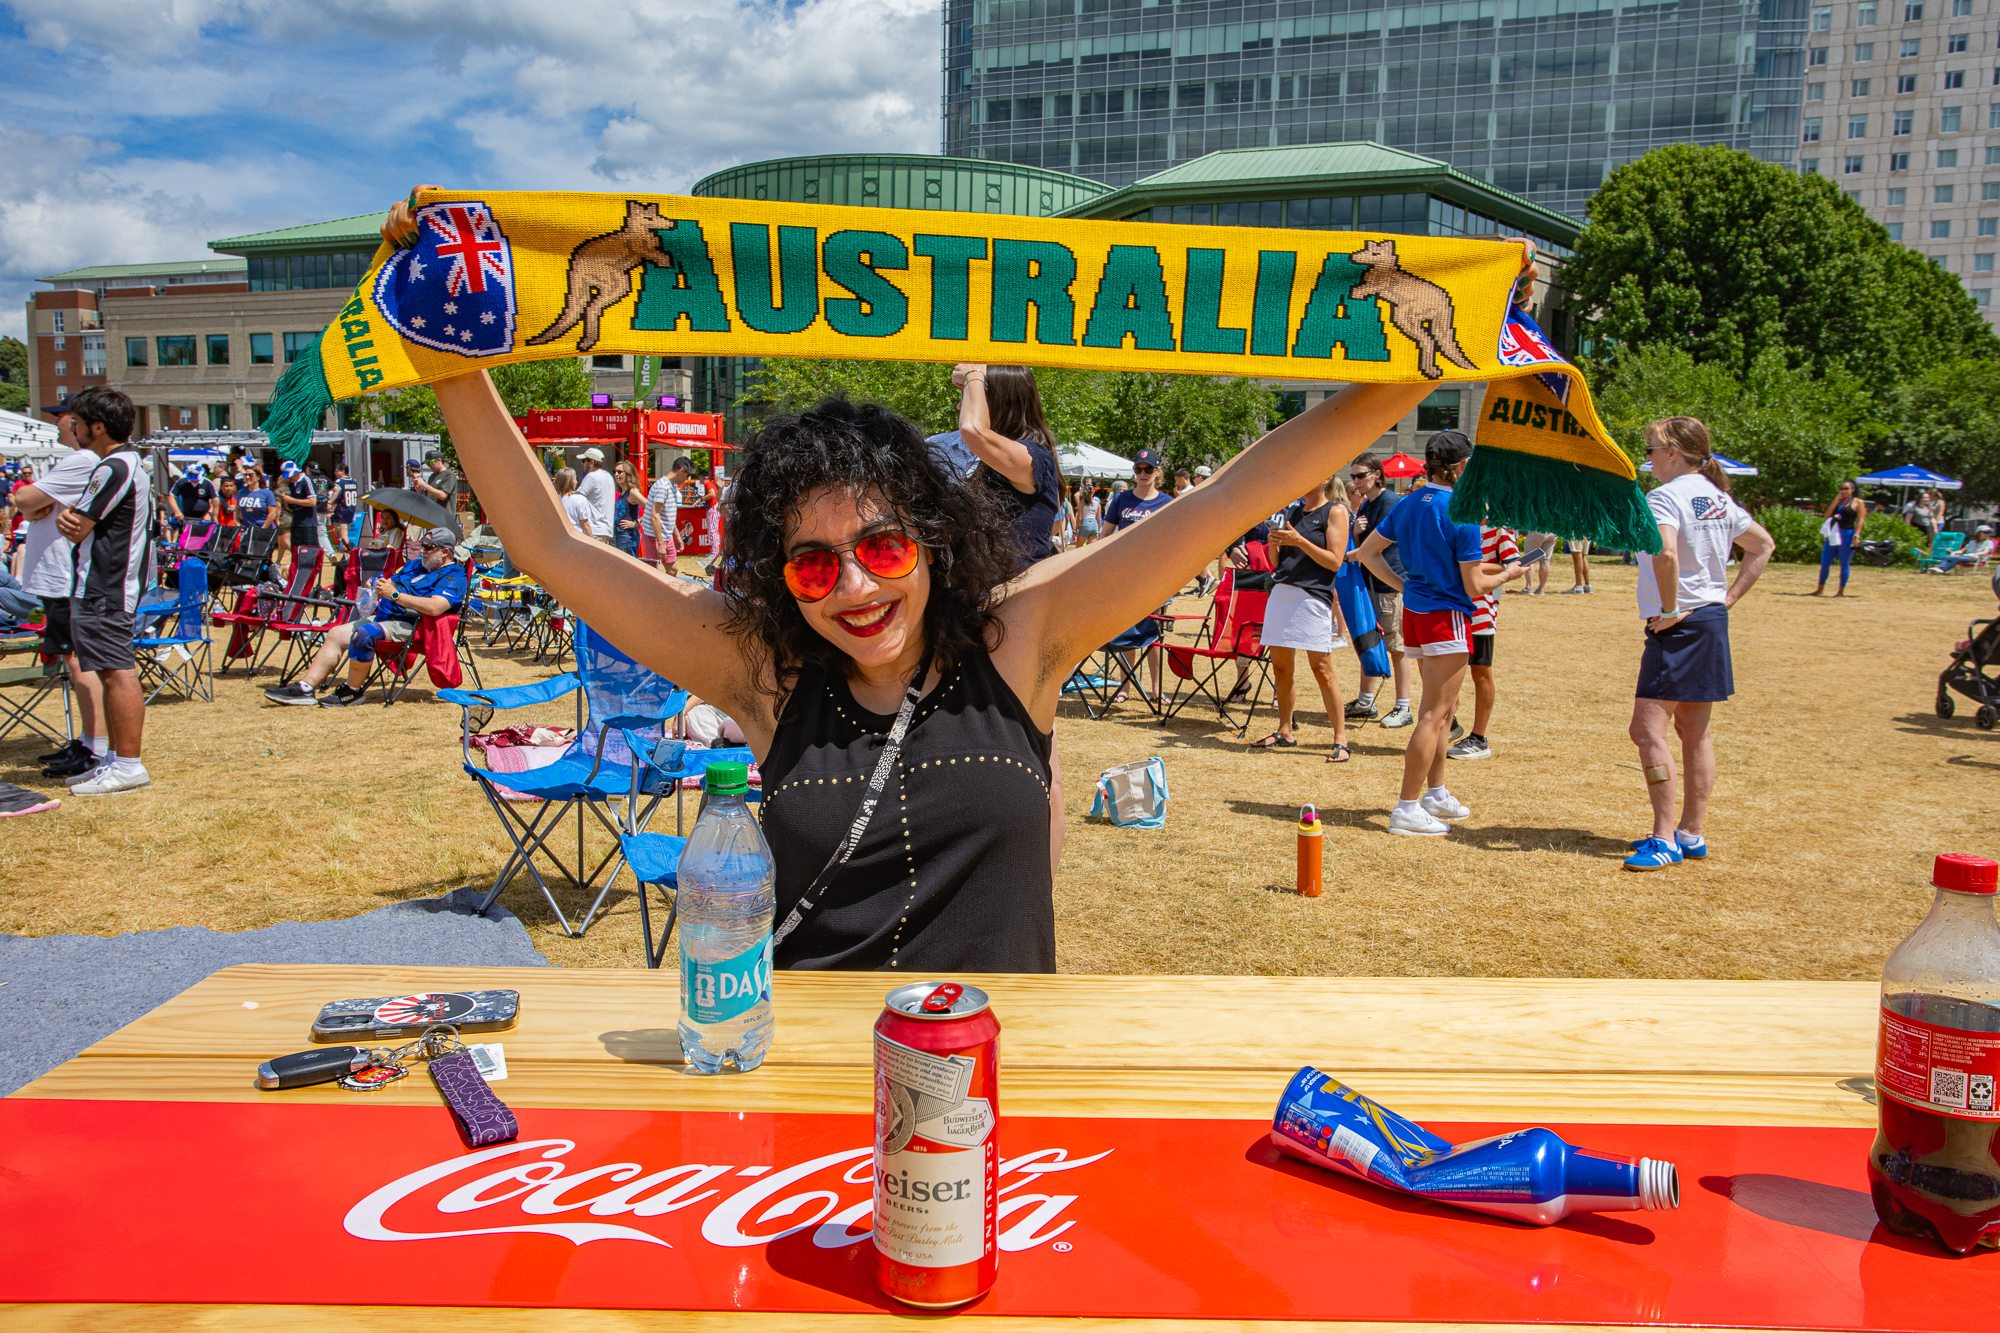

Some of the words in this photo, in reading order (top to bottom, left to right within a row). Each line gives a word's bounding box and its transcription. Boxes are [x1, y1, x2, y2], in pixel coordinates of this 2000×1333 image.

[630, 219, 1390, 362] AUSTRALIA
[668, 422, 707, 436] INFORMATION
[238, 497, 262, 508] USA
[914, 1058, 931, 1068] brand
[931, 1064, 956, 1074] produced
[919, 1075, 952, 1088] smoothness
[943, 1111, 984, 1125] BUDWEISER
[947, 1126, 970, 1135] LAGER
[968, 1121, 986, 1135] BEER
[985, 1142, 993, 1255] GENUINE
[891, 1220, 918, 1231] process
[919, 1222, 942, 1234] from
[944, 1222, 959, 1232] the
[886, 1227, 905, 1241] Best
[905, 1233, 939, 1248] Barley
[938, 1233, 968, 1246] Malt
[899, 1249, 913, 1257] THE
